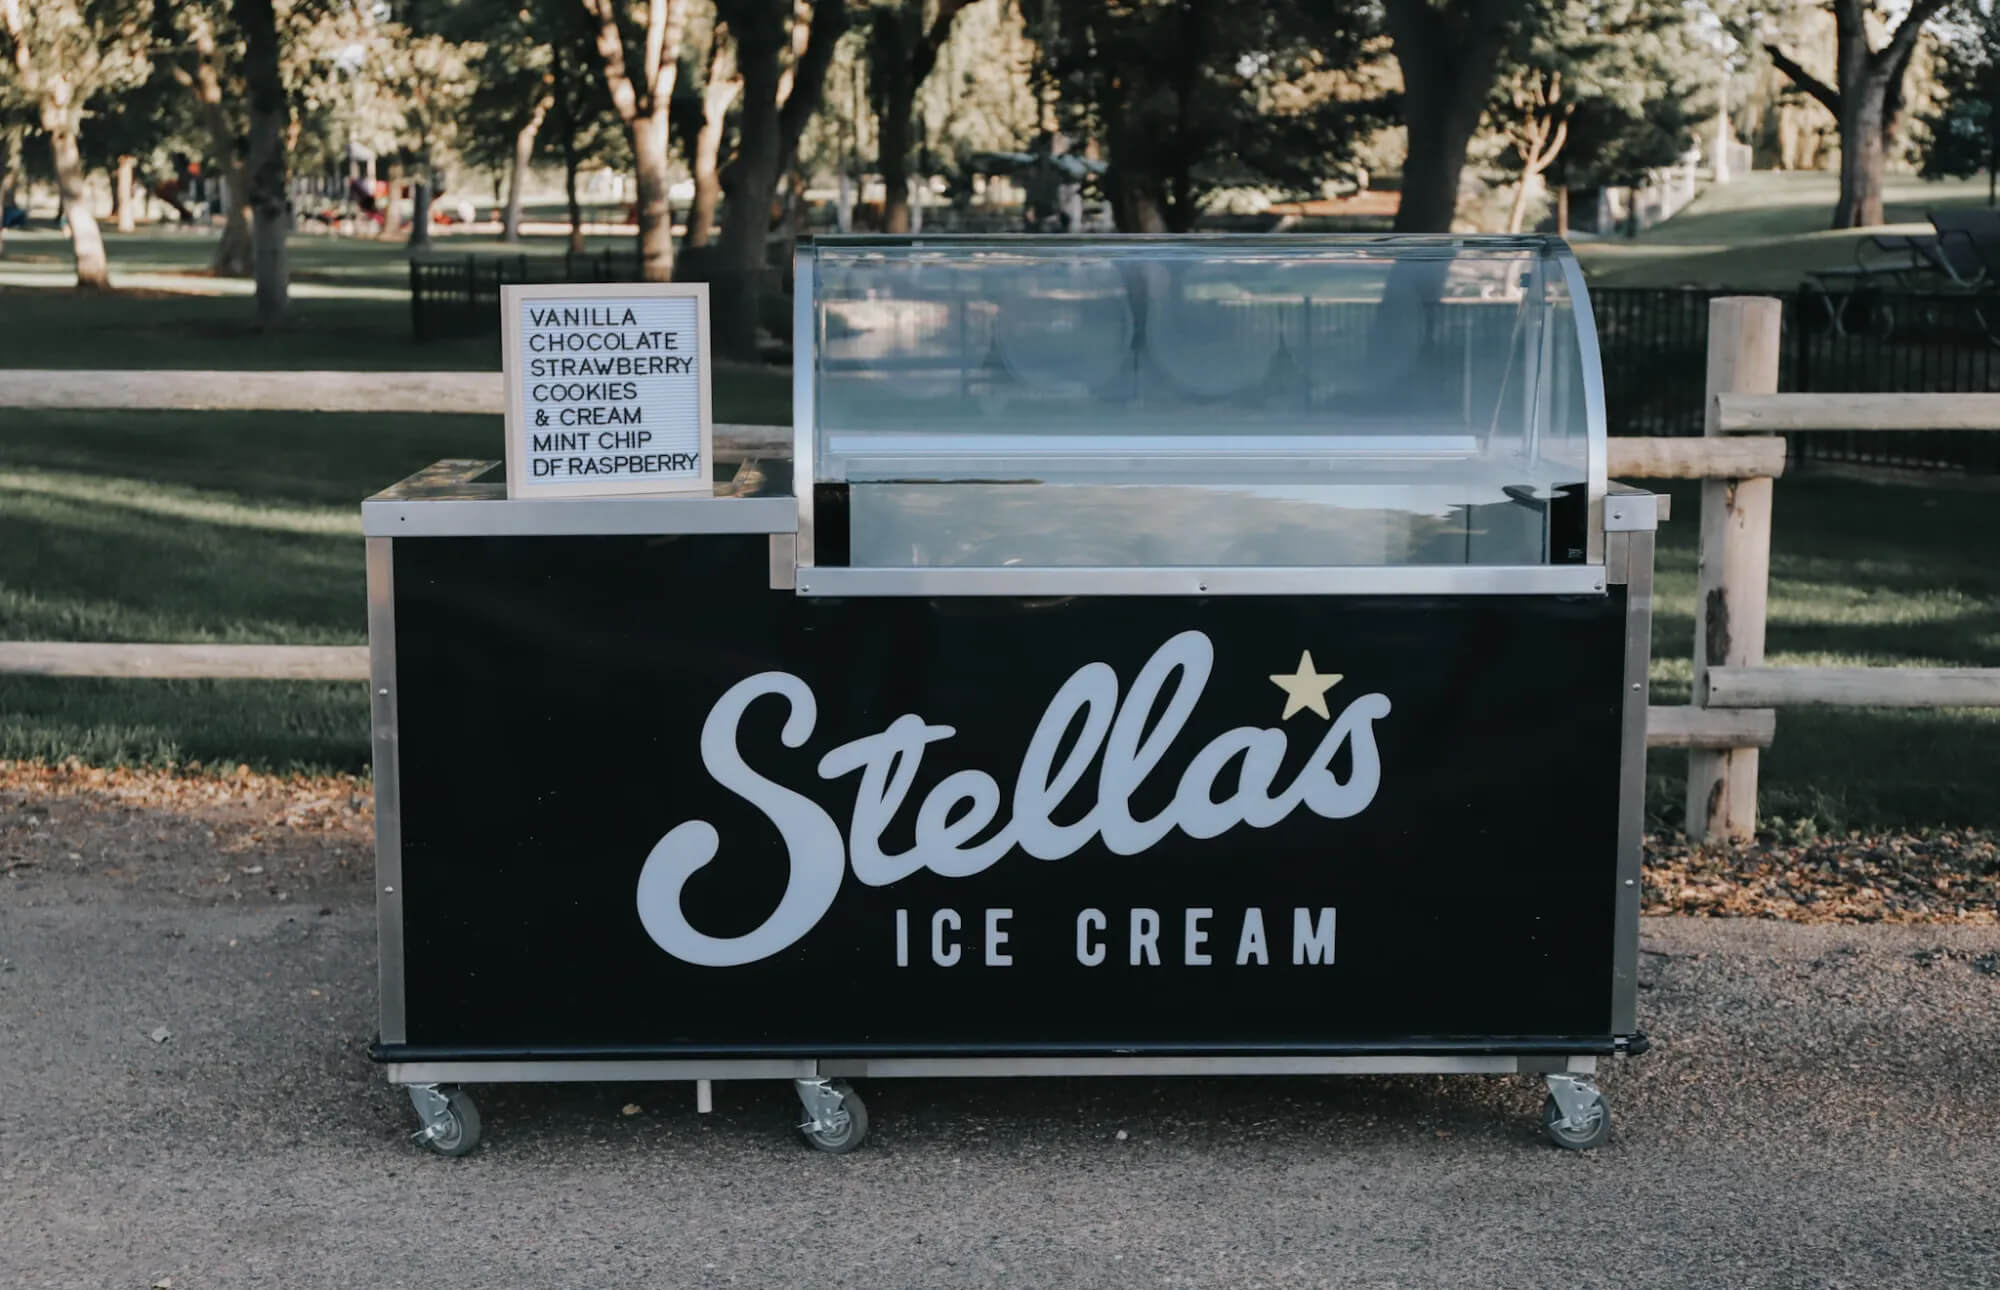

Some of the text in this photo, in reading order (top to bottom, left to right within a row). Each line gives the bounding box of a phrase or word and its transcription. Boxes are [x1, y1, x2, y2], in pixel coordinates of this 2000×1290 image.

[530, 307, 637, 327] VANILLA
[529, 331, 678, 352] CHOCOLATE
[530, 356, 693, 377] STRAWBERRY
[532, 382, 638, 402] COOKIES
[535, 406, 642, 427] & CREAM
[533, 430, 652, 453] MINT CHIP
[532, 452, 699, 477] DF RASPBERRY
[896, 908, 1337, 966] ICE CREAM
